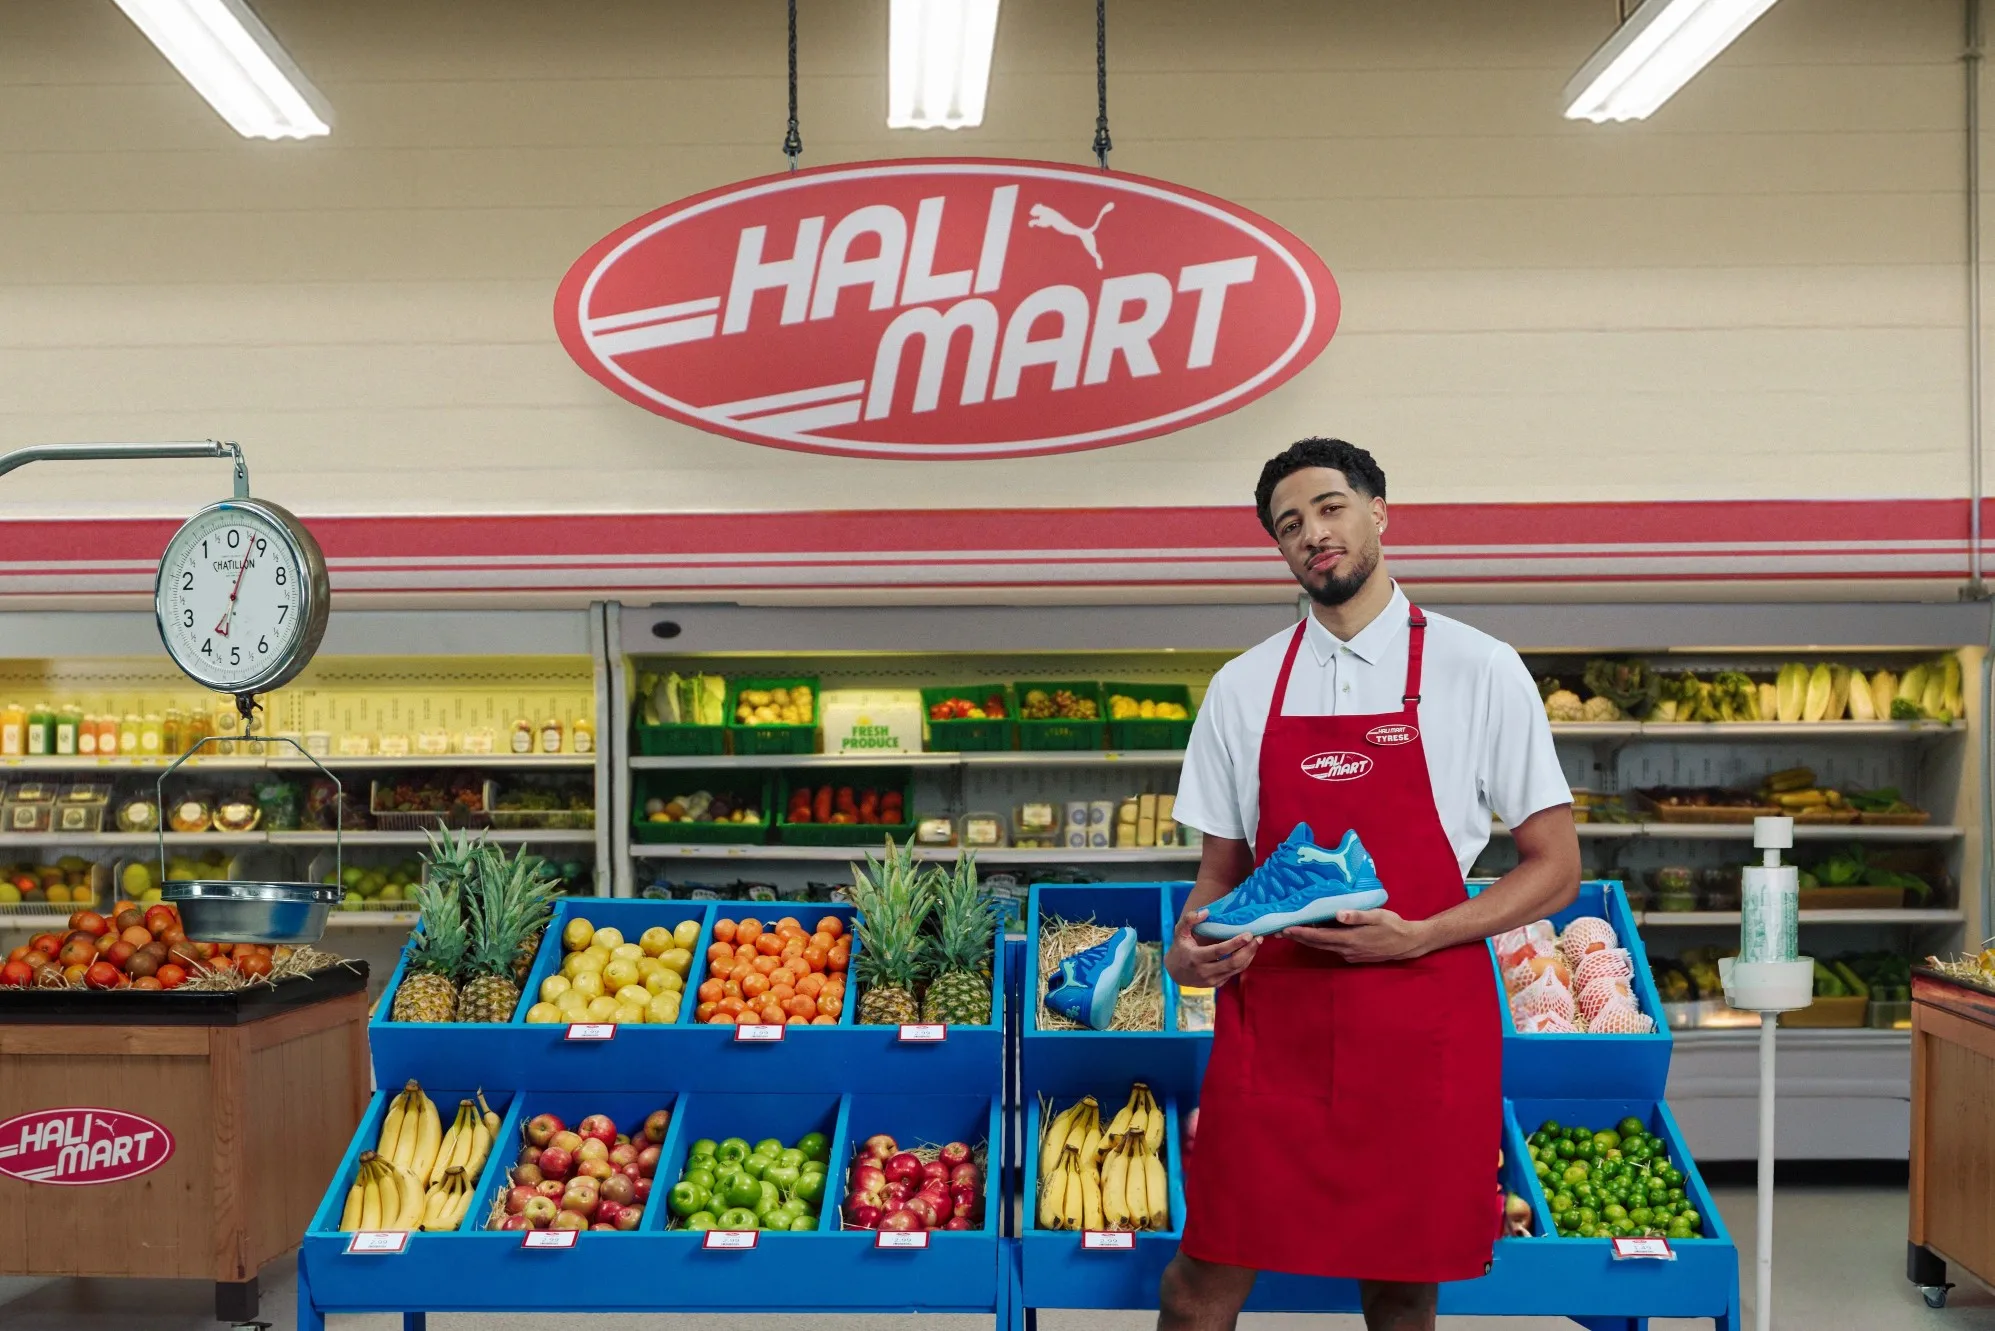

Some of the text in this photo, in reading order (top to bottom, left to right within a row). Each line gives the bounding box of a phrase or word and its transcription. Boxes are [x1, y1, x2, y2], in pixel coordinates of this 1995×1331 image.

[722, 184, 1019, 335] HALI
[865, 256, 1257, 422] MART
[227, 529, 240, 549] 0
[256, 538, 267, 557] 9
[202, 540, 207, 558] 1
[213, 559, 255, 572] CHATILLON
[182, 571, 193, 591] 2
[276, 566, 286, 586] 8
[183, 609, 194, 628] 3
[277, 605, 289, 624] 7
[201, 638, 212, 656] 4
[257, 634, 268, 654] 6
[230, 647, 240, 666] 5
[852, 726, 889, 736] FRESH
[1376, 733, 1409, 743] TYRESE
[842, 737, 899, 749] PRODUCE
[1315, 753, 1346, 769] HALI
[1328, 760, 1368, 777] MART
[19, 1113, 93, 1154] HALI
[56, 1131, 154, 1176] MART
